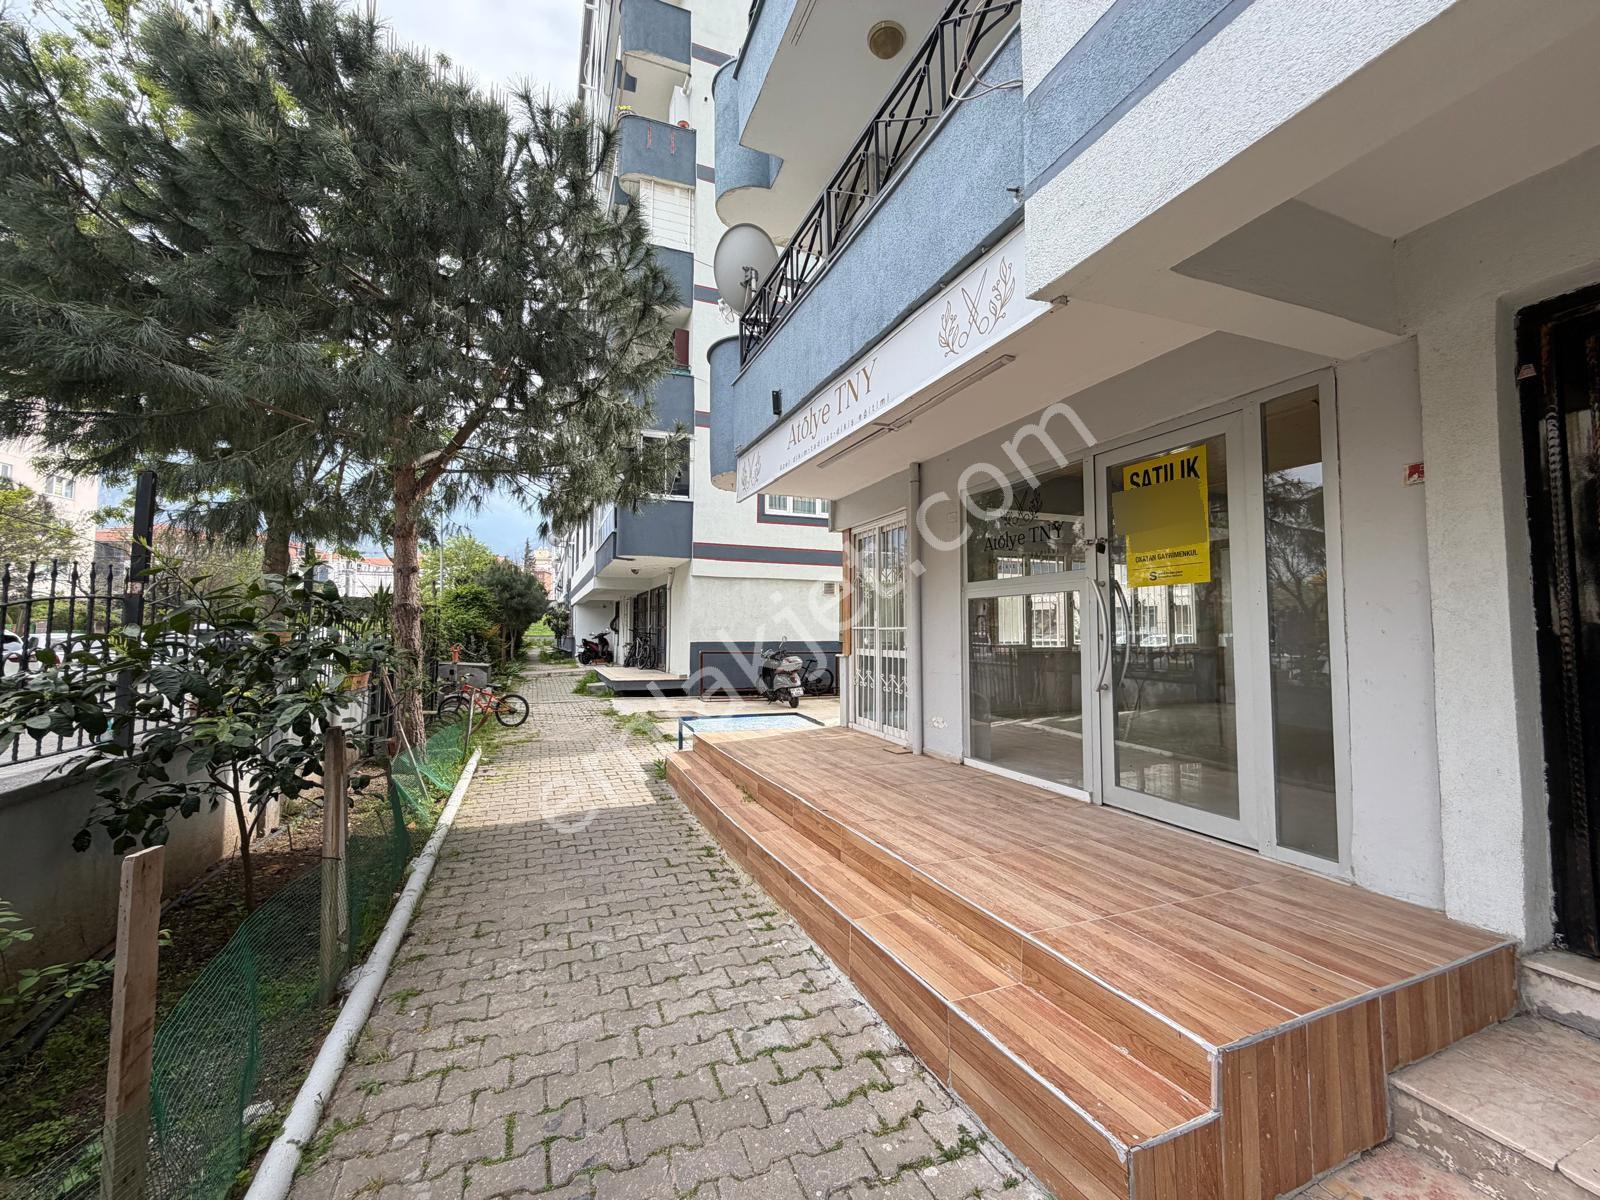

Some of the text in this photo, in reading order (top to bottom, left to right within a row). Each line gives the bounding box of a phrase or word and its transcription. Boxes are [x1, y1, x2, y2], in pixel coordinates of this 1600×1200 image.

[787, 357, 878, 450] Atölye TNY
[1029, 521, 1065, 543] TNY
